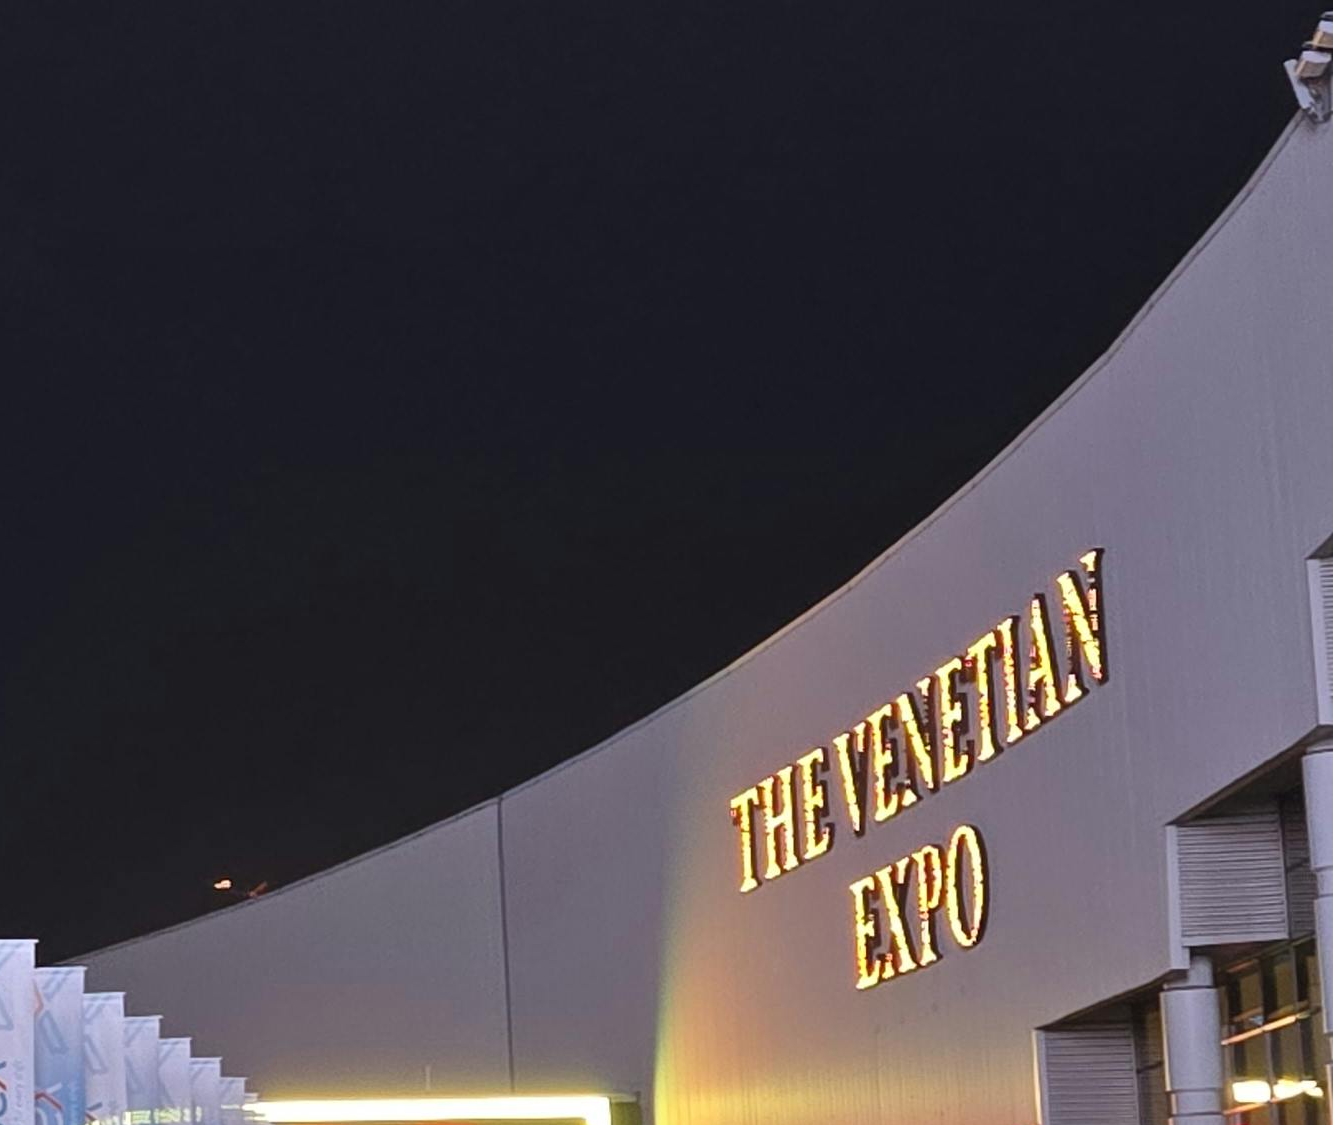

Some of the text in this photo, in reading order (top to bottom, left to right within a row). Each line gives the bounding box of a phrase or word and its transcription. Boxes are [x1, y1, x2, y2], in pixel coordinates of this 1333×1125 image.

[730, 547, 1106, 893] THE VENETIAN
[849, 824, 990, 991] EXPO
